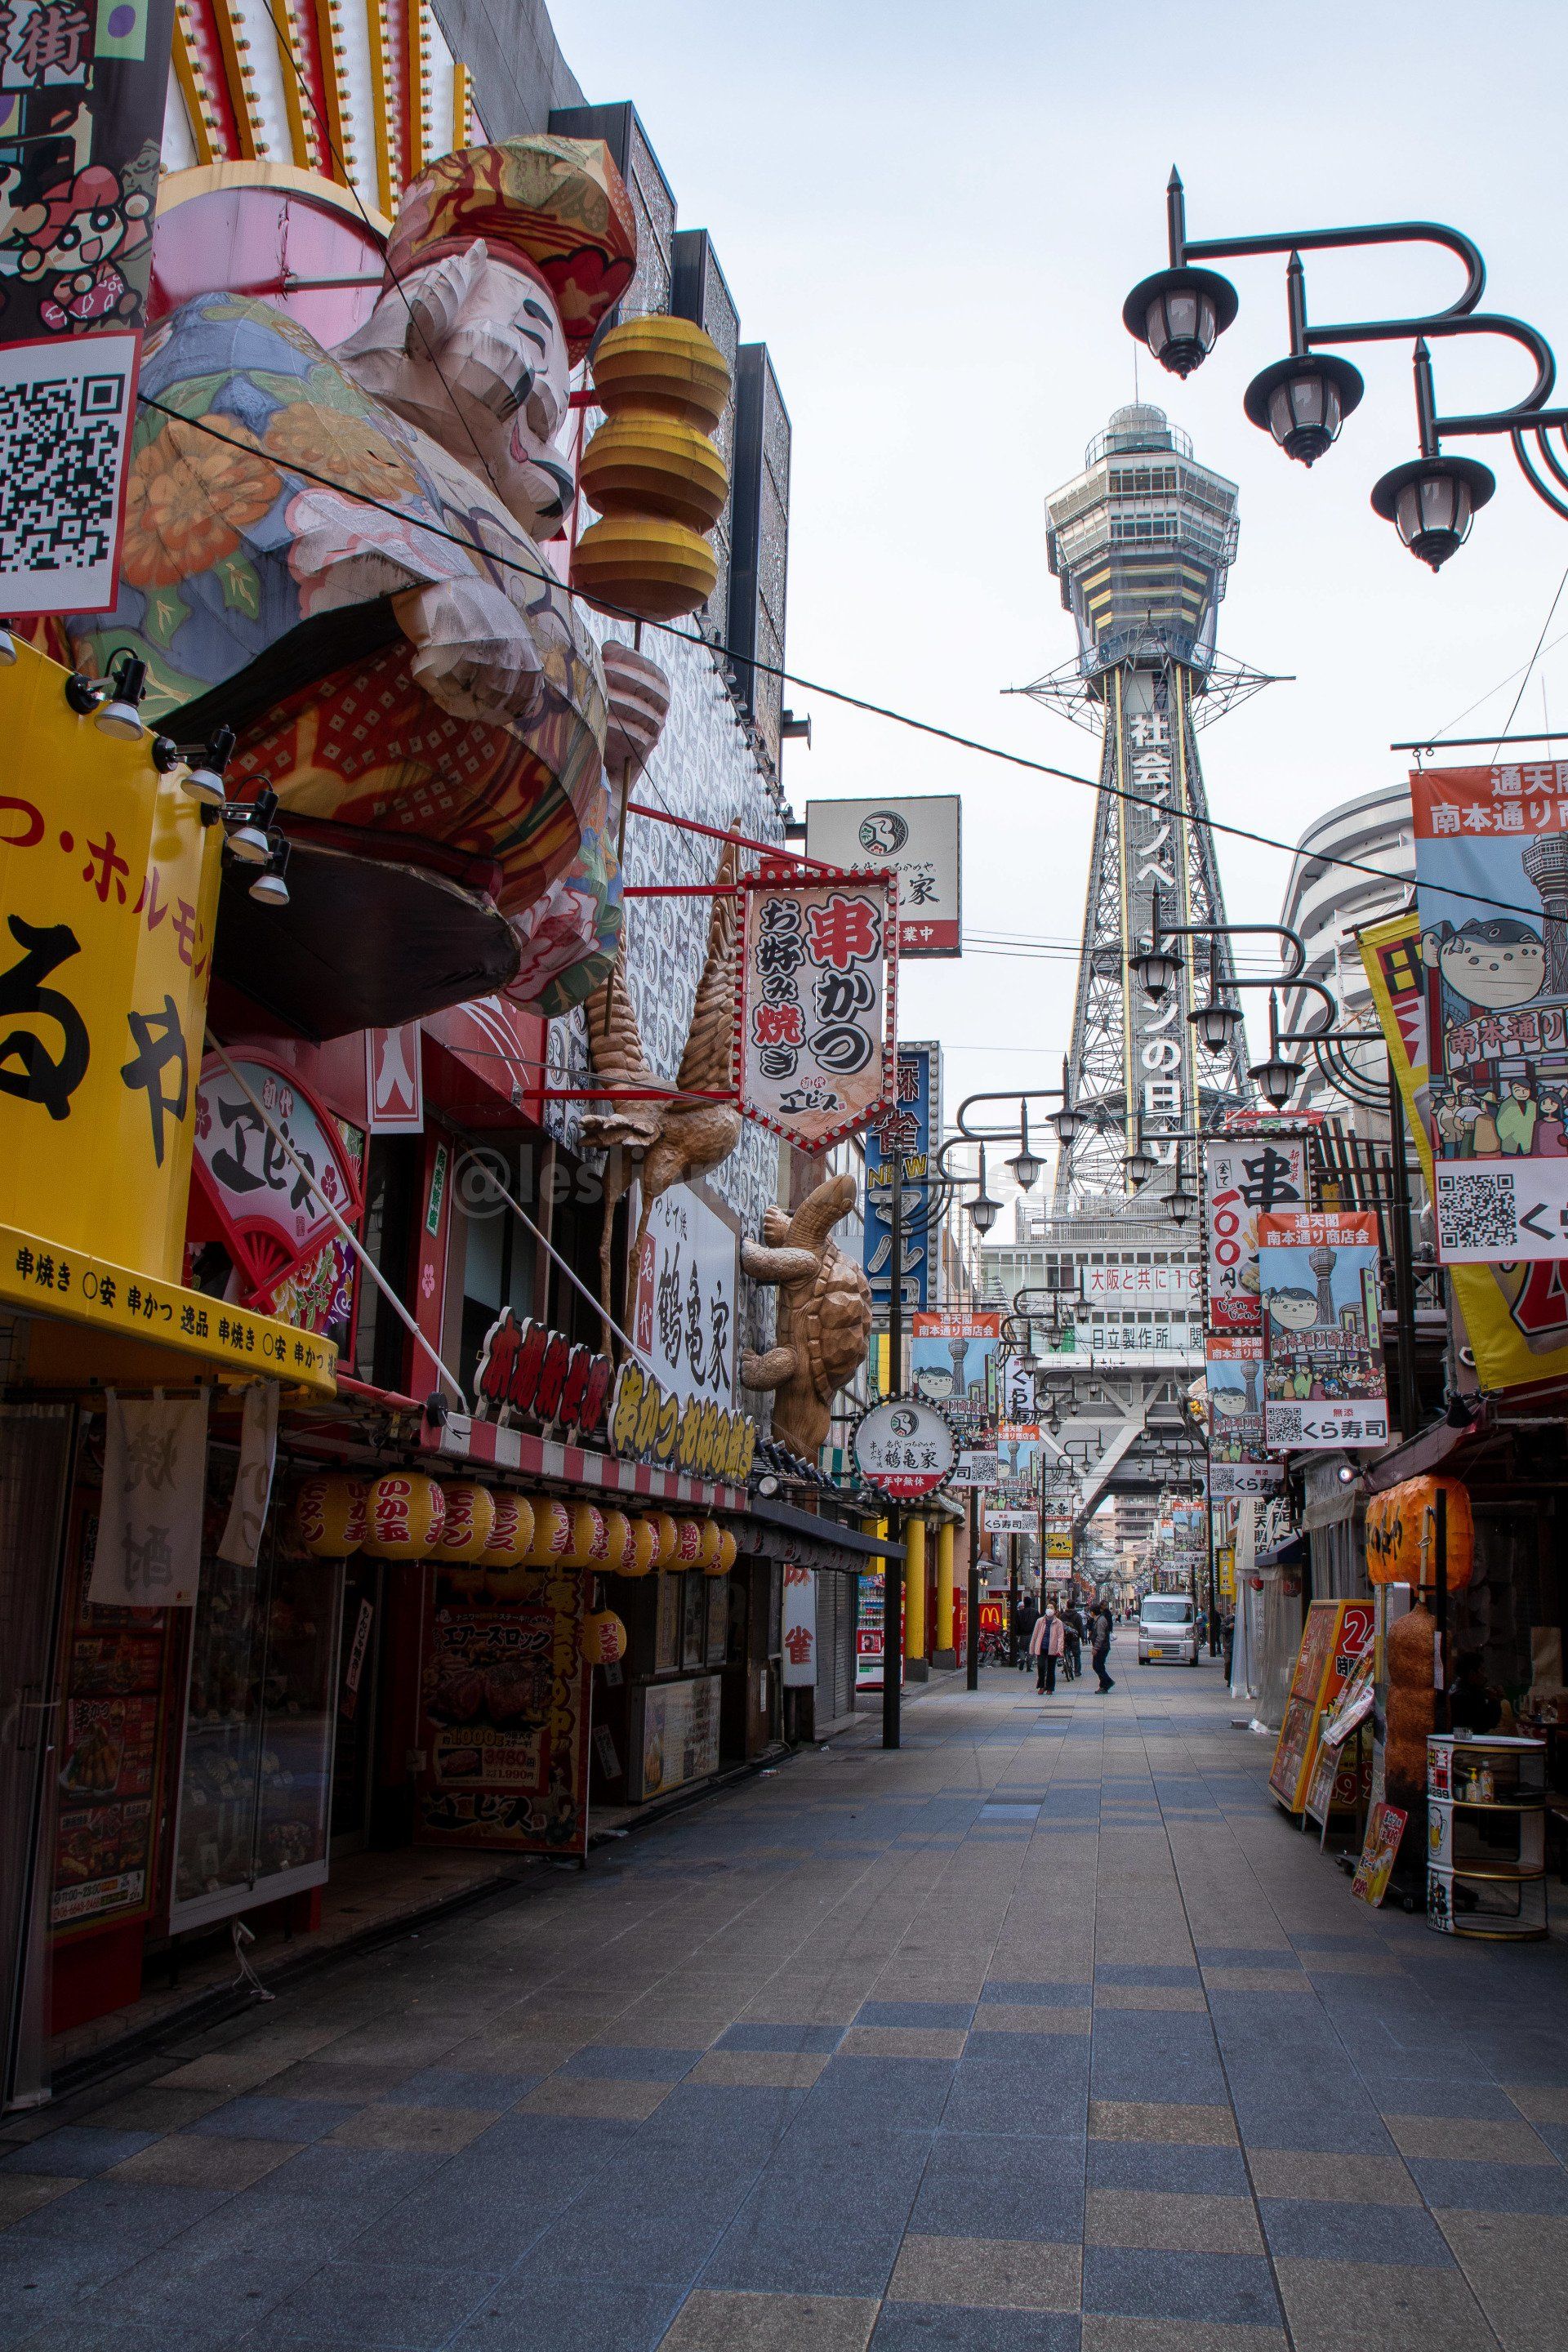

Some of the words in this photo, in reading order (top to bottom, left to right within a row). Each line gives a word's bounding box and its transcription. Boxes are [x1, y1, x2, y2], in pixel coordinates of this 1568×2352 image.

[0, 7, 90, 78] 街
[890, 925, 933, 942] 業中
[754, 899, 805, 1078] お好み焼き
[808, 895, 880, 1074] 串かつ
[1216, 1161, 1230, 1186] 全て
[1238, 1147, 1300, 1214] 串
[1295, 1214, 1339, 1229] 通天閣
[1267, 1228, 1370, 1245] 南本通り商店会
[16, 1246, 71, 1291] 串焼き
[127, 1285, 174, 1321] 串かつ
[218, 1316, 256, 1352] 串焼き
[294, 1339, 324, 1369] 串かつ
[940, 1313, 973, 1325] 通天閣
[919, 1325, 994, 1337] 南本通り商店会
[1093, 1328, 1169, 1350] 日立製作所
[1232, 1338, 1263, 1348] 通天閣
[1333, 1408, 1354, 1417] 無添
[1303, 1419, 1387, 1440] くら寿司
[985, 1520, 1022, 1530] くら寿司
